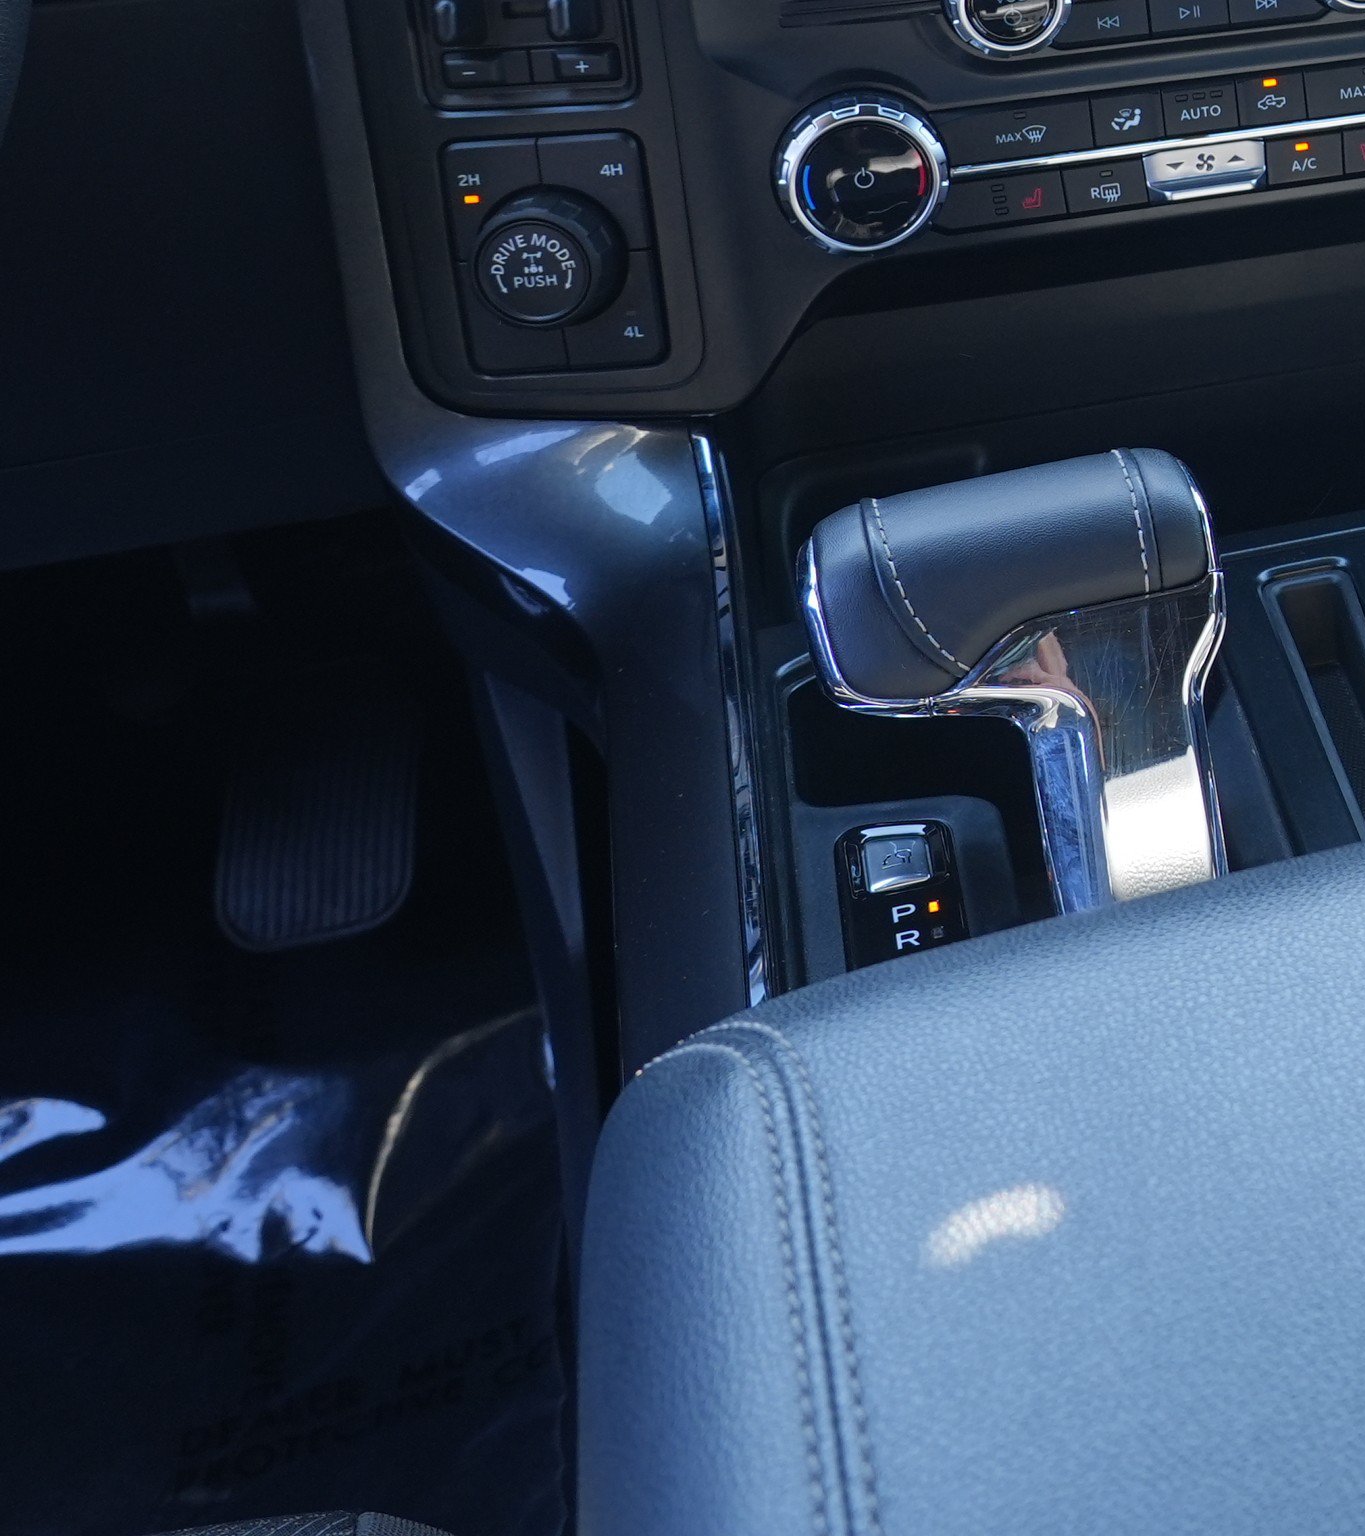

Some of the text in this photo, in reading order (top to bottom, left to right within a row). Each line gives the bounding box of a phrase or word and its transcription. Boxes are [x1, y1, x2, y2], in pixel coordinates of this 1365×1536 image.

[1180, 104, 1221, 121] AUTO
[995, 132, 1022, 145] MAX
[600, 163, 623, 177] 4H
[1291, 158, 1317, 172] A/C
[457, 174, 480, 187] 2H
[490, 233, 576, 275] DRIVE MODE
[513, 274, 558, 289] PUSH
[623, 326, 644, 338] 4L
[892, 903, 916, 923] P
[895, 929, 920, 950] R
